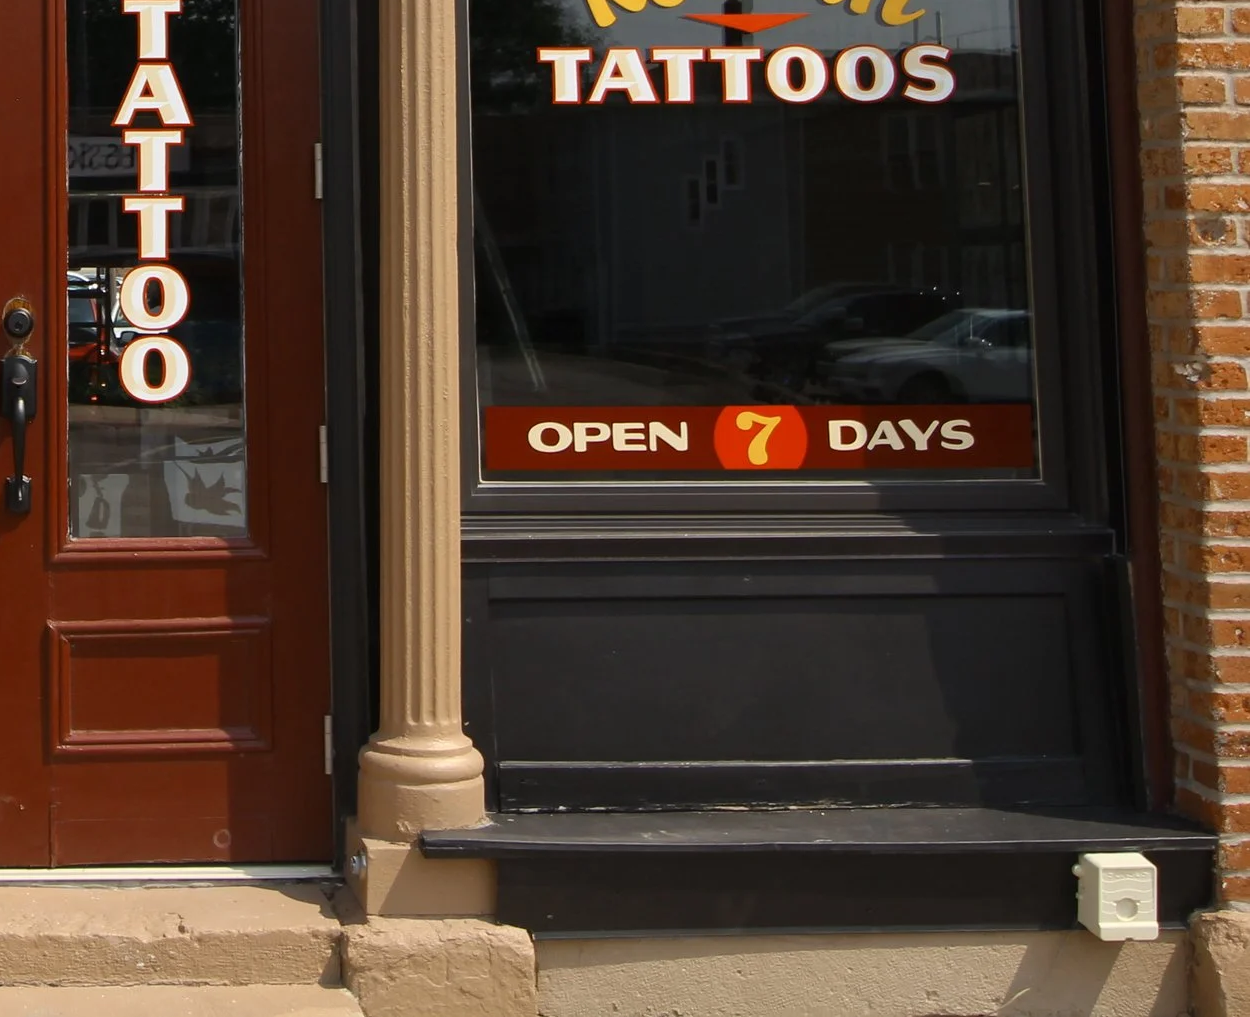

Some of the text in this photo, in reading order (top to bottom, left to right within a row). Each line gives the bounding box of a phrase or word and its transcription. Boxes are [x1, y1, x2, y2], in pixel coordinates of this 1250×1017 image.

[538, 44, 957, 105] TATTOOS
[527, 411, 976, 465] OPEN 7 DAYS
